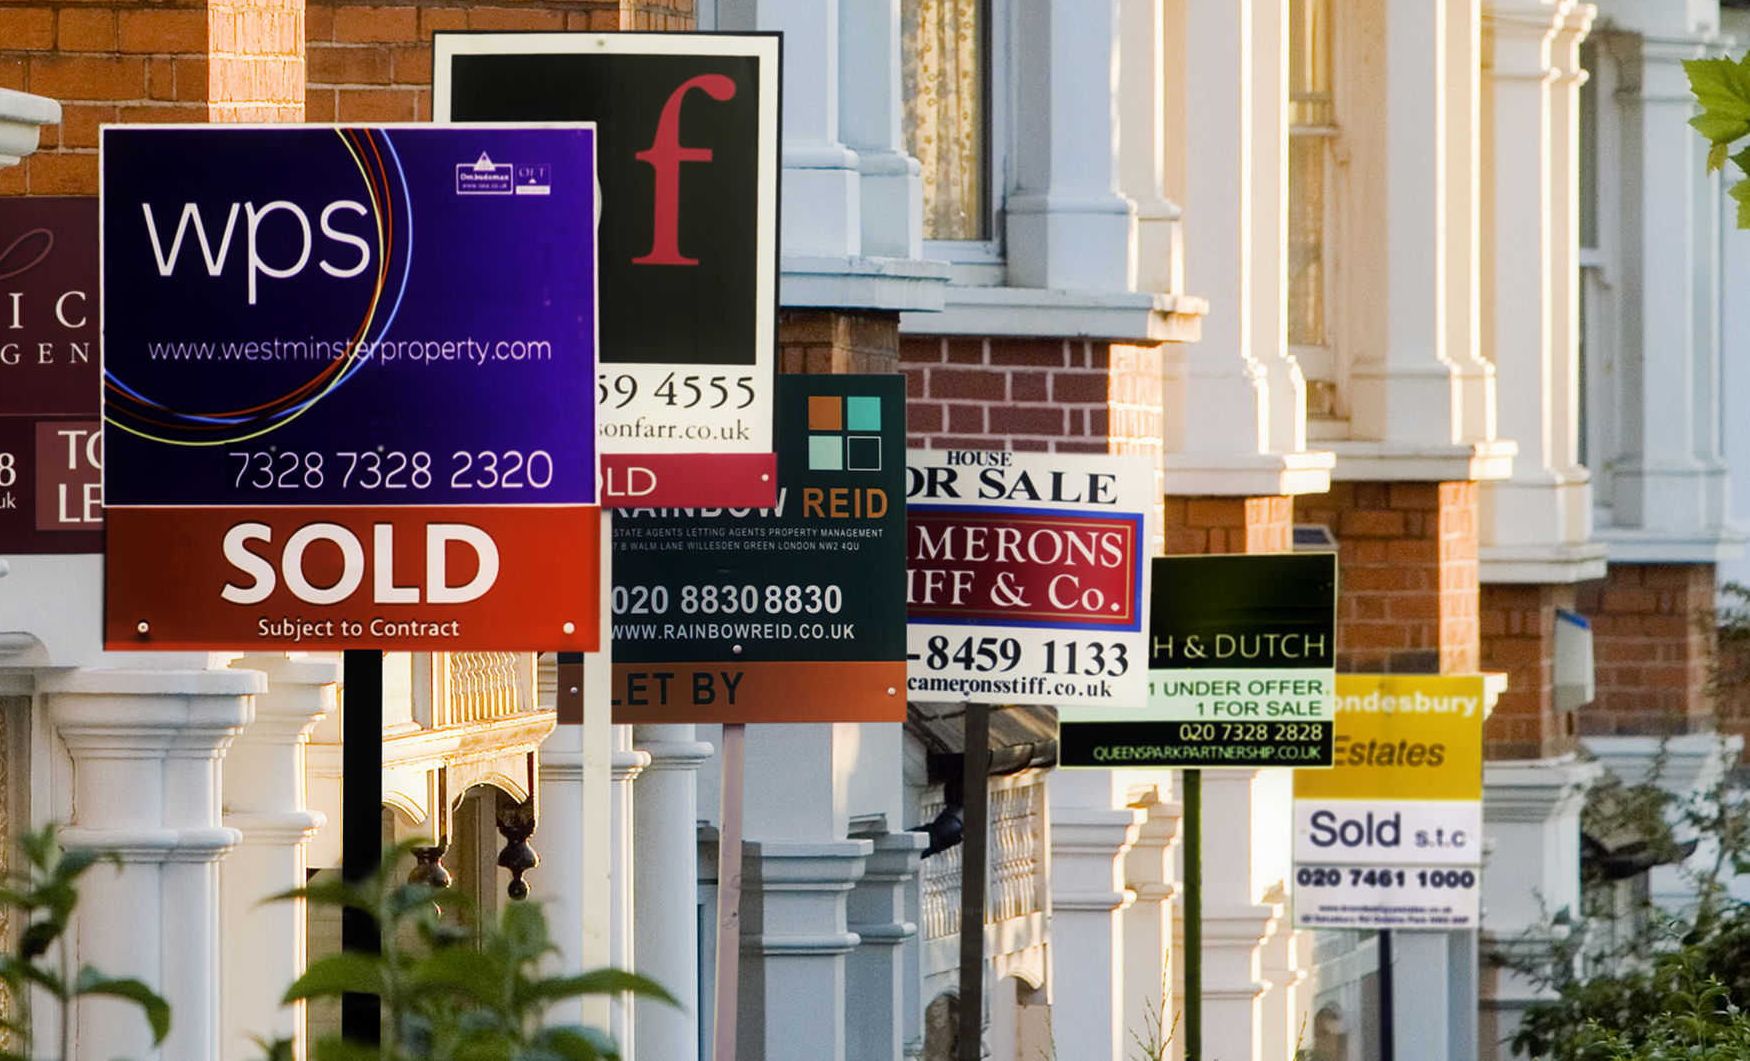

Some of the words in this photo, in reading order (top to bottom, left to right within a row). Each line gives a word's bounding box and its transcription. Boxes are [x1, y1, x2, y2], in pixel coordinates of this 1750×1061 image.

[632, 74, 736, 266] f
[142, 200, 370, 305] wps
[148, 336, 552, 366] www.westminsterproperty.com
[654, 371, 756, 409] 4555
[229, 450, 324, 490] 7328
[336, 450, 432, 490] 7328
[451, 450, 553, 490] 2320
[947, 450, 1013, 467] HOUSE
[600, 466, 657, 497] LD
[978, 467, 1118, 504] SALE
[803, 487, 888, 519] REID
[630, 541, 658, 551] WALM
[660, 541, 684, 551] LANE
[687, 541, 741, 551] WILLESDEN
[743, 541, 776, 551] GREEN
[778, 541, 817, 551] LONDON
[819, 541, 839, 551] NW2
[645, 527, 683, 538] AGENTS
[686, 527, 726, 538] LETTING
[729, 527, 766, 538] AGENTS
[768, 527, 818, 538] PROPERTY
[820, 528, 884, 538] MANAGEMENT
[906, 525, 1122, 568] MERONS
[221, 522, 500, 605] SOLD
[611, 585, 669, 614] 020
[990, 571, 1032, 607] &
[1048, 574, 1120, 612] Co.
[258, 619, 334, 643] Subject
[342, 621, 363, 637] to
[370, 619, 460, 637] Contract
[611, 623, 855, 640] WWW.RAINBOWREID.CO.UK
[1041, 639, 1129, 677] 1133
[1153, 635, 1173, 659] H
[1183, 635, 1207, 659] &
[1216, 634, 1325, 659] DUTCH
[692, 671, 744, 706] BY
[907, 676, 1113, 698] cameronsstiff.co.uk
[1164, 680, 1241, 697] UNDER
[1196, 702, 1205, 716] 1
[1213, 701, 1260, 717] FOR
[1266, 700, 1323, 717] SALE
[1179, 724, 1215, 741] 020
[1221, 724, 1268, 741] 7328
[1274, 724, 1323, 741] 2828
[1093, 745, 1322, 761] QUEENSPARKPARTNERSHIP.CO.UK
[1310, 810, 1401, 847] Sold
[1296, 867, 1341, 887] 020
[1348, 868, 1406, 888] 7461
[1418, 869, 1476, 889] 1000
